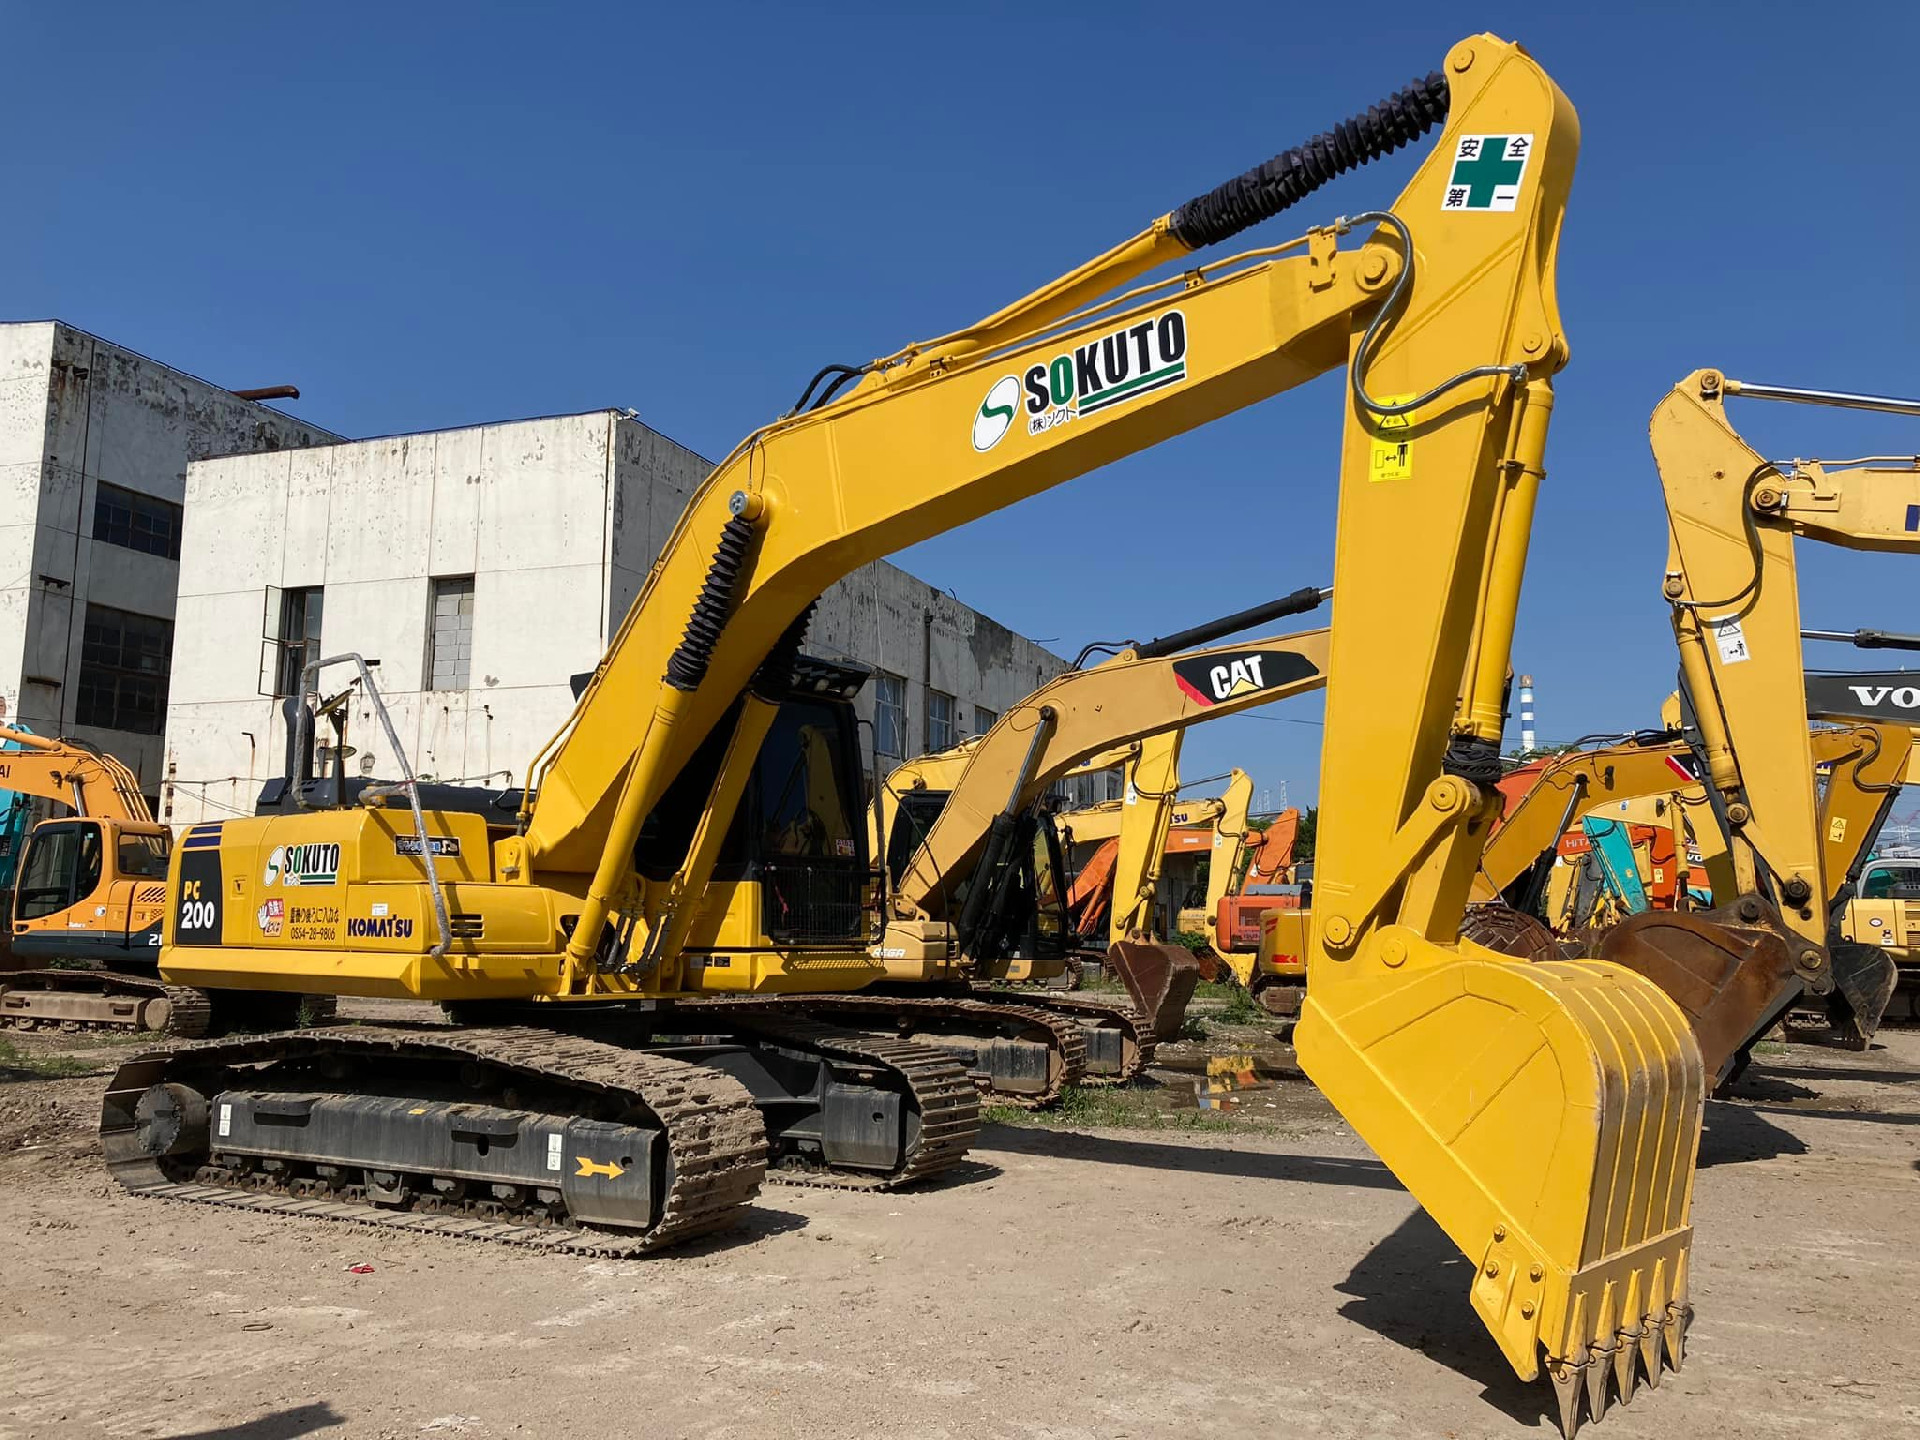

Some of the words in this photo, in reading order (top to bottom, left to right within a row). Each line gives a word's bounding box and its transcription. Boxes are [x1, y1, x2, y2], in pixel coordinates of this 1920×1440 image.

[1025, 312, 1186, 414] SOKUTO
[1210, 654, 1264, 699] CAT
[1848, 686, 1920, 708] VO
[285, 844, 340, 874] SOKUTO
[183, 881, 201, 900] PC
[181, 901, 215, 929] 200
[347, 914, 413, 938] KOMATSU
